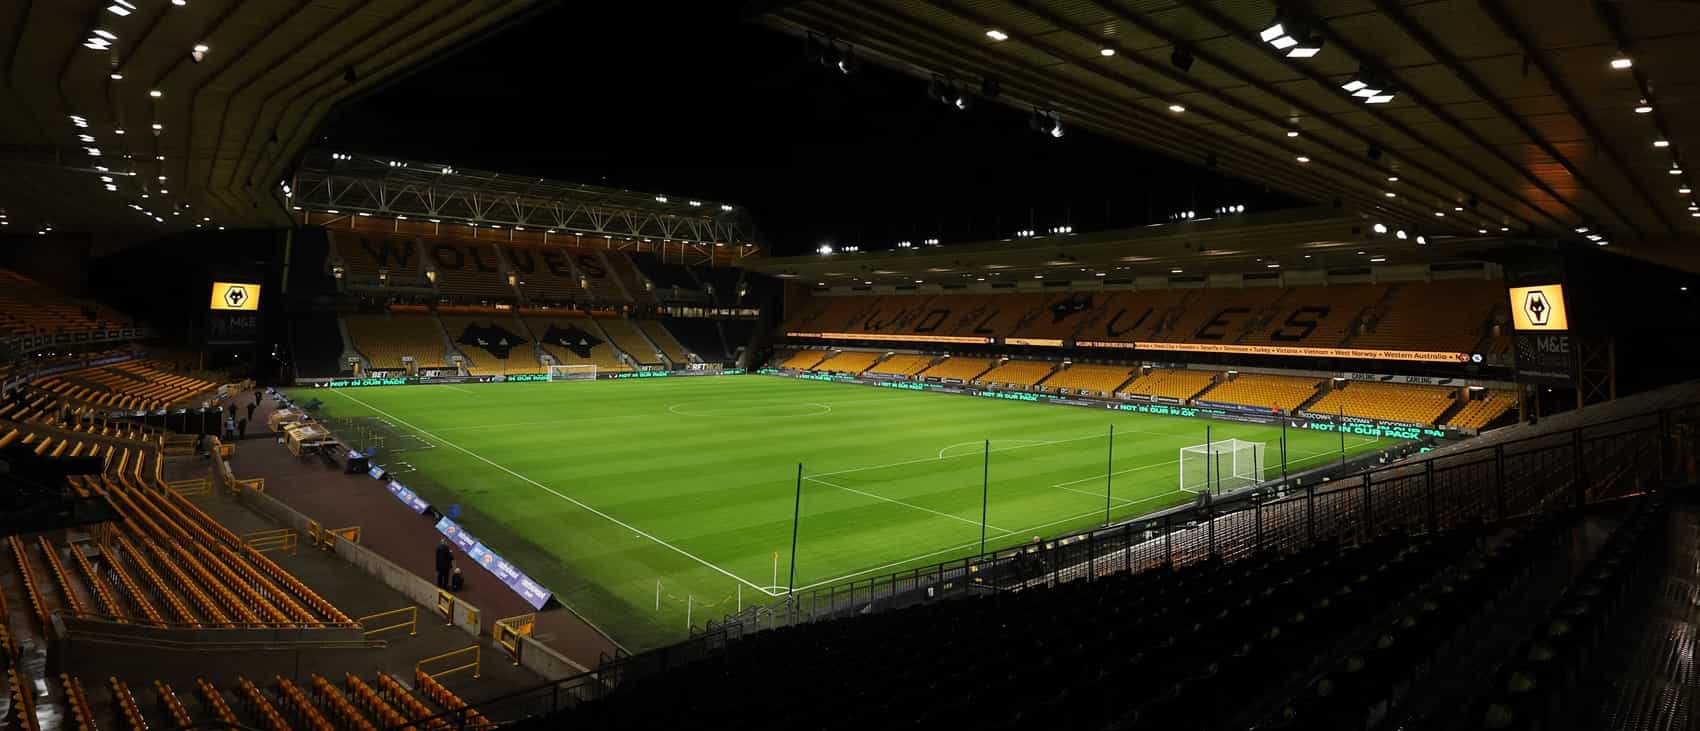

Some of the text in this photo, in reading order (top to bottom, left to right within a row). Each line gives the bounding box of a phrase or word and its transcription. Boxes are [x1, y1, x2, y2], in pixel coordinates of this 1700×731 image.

[360, 237, 608, 278] WOLVES
[864, 307, 1329, 340] WOLVES
[1537, 336, 1568, 352] M&E
[1150, 406, 1168, 414] OUR
[1354, 427, 1381, 436] OUR
[1385, 430, 1419, 440] PACK
